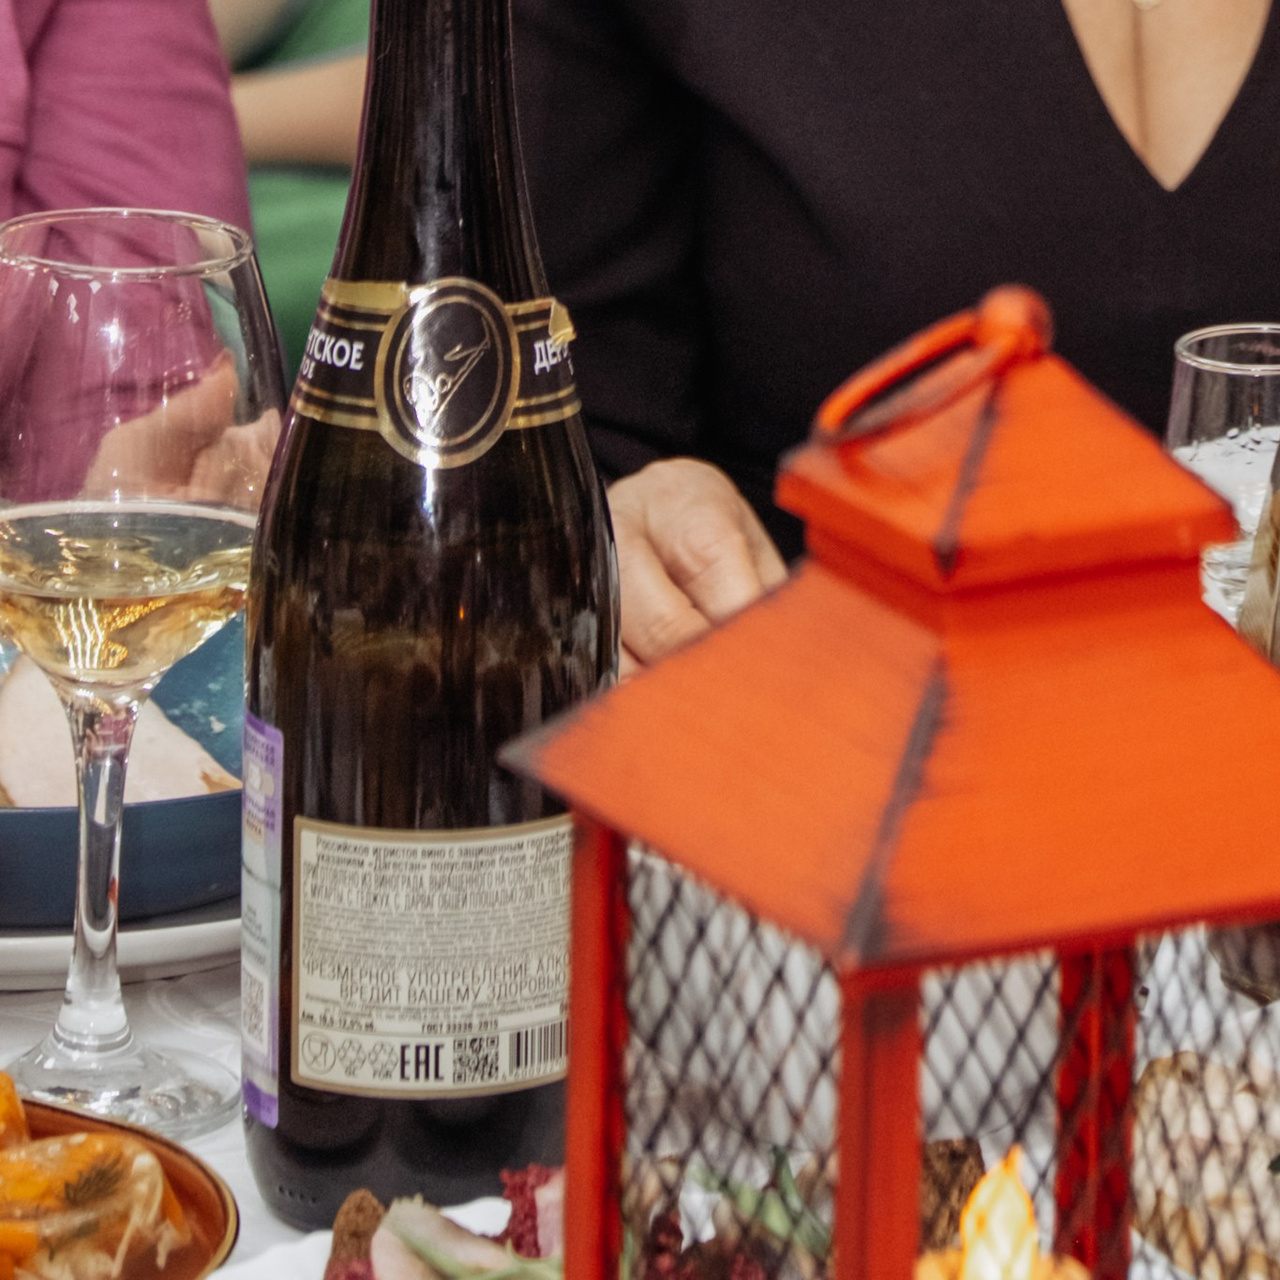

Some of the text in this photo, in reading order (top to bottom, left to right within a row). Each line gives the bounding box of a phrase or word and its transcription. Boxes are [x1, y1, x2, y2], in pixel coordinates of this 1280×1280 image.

[316, 835, 369, 857] Российское
[372, 846, 418, 864] игристое
[421, 848, 446, 859] вино
[448, 848, 455, 858] с
[457, 841, 524, 859] защищенным
[430, 858, 497, 874] полусладкое
[498, 853, 527, 867] белое
[302, 958, 400, 987] ЧРЕЗМЕРНОЕ
[406, 963, 529, 989] УПОТРЕБЛЕНИЕ
[340, 970, 567, 1006] ВРЕДИТ ВАШЕМУ ЗДОРОВЬЮ
[399, 1043, 445, 1082] EAC
